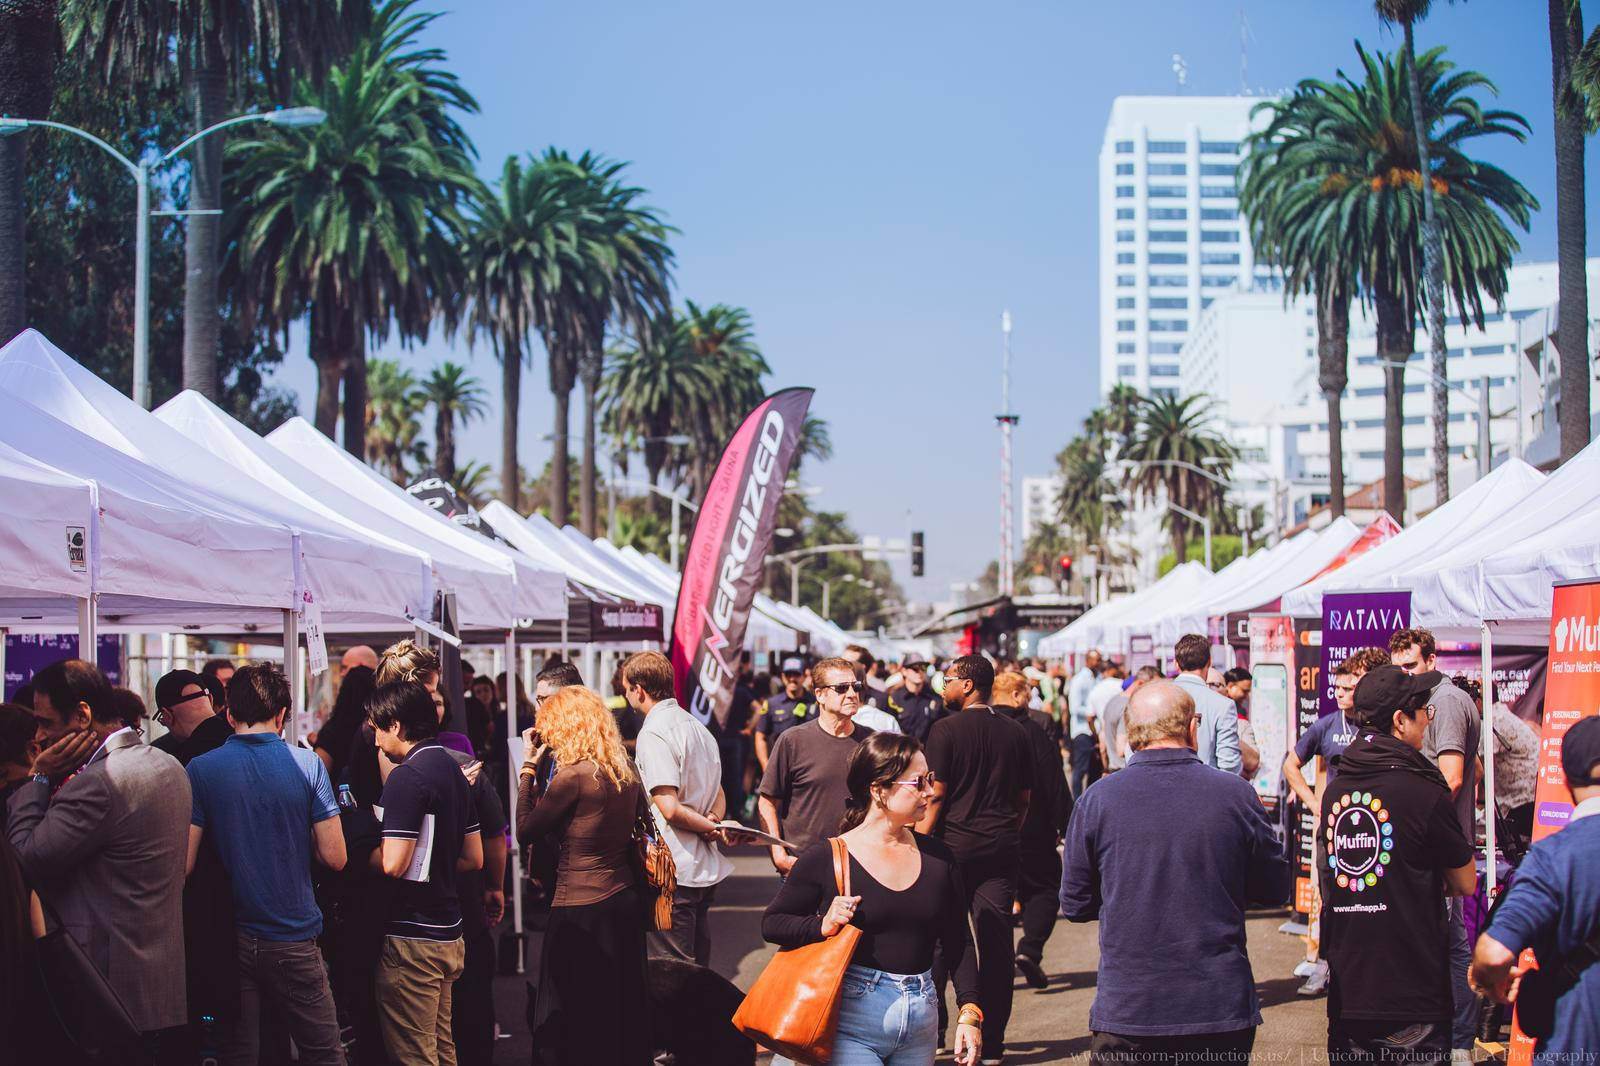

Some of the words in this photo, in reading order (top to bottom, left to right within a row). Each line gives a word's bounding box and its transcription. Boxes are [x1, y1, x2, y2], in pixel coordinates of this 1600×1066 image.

[721, 449, 739, 494] SAUNA
[1329, 608, 1404, 630] RATAVA
[1569, 616, 1600, 652] Mu
[1328, 646, 1347, 659] THE
[1564, 661, 1575, 673] Your
[1576, 661, 1592, 673] Next
[1336, 832, 1376, 850] Muffin
